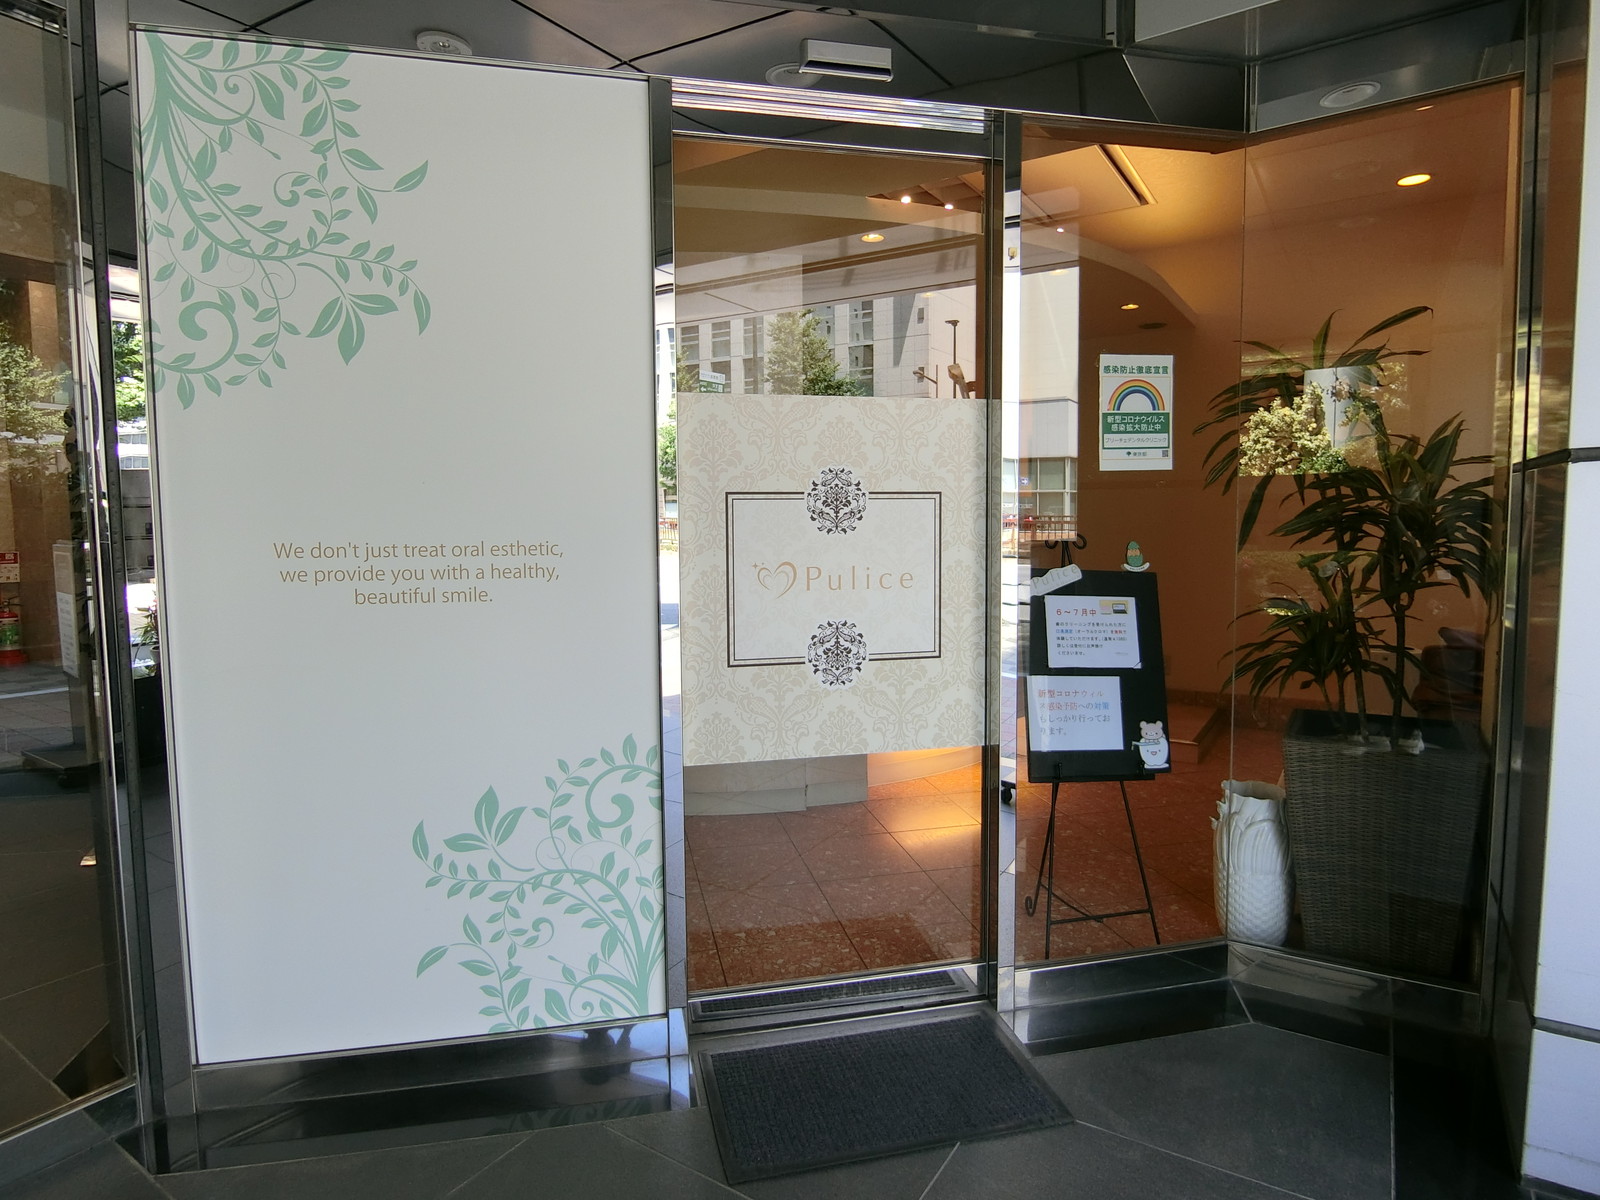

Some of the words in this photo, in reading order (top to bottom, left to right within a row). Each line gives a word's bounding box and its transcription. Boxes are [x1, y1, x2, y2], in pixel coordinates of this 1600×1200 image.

[1103, 365, 1169, 375] 感染防止徹底宣言
[1107, 415, 1165, 424] 新型コロナウイルス
[1111, 424, 1162, 432] 感染拡大防止中
[273, 542, 305, 558] We
[310, 541, 360, 558] don't
[364, 543, 398, 562] just
[403, 543, 447, 558] treat
[452, 541, 484, 558] oral
[490, 540, 564, 558] esthetic,
[280, 570, 308, 582] we
[314, 565, 385, 586] provide
[391, 569, 425, 585] you
[430, 564, 470, 580] with
[475, 568, 485, 579] a
[490, 563, 560, 582] healthy,
[806, 566, 914, 591] Pulice
[1032, 565, 1080, 589] Pulice
[354, 587, 436, 605] beautiful
[442, 586, 493, 603] smile.
[1038, 689, 1104, 699] 新型コロナウィル
[1040, 702, 1110, 711] ス感染予防への対策
[1040, 714, 1111, 723] もしっかり行ってお
[1040, 727, 1067, 736] ります。
